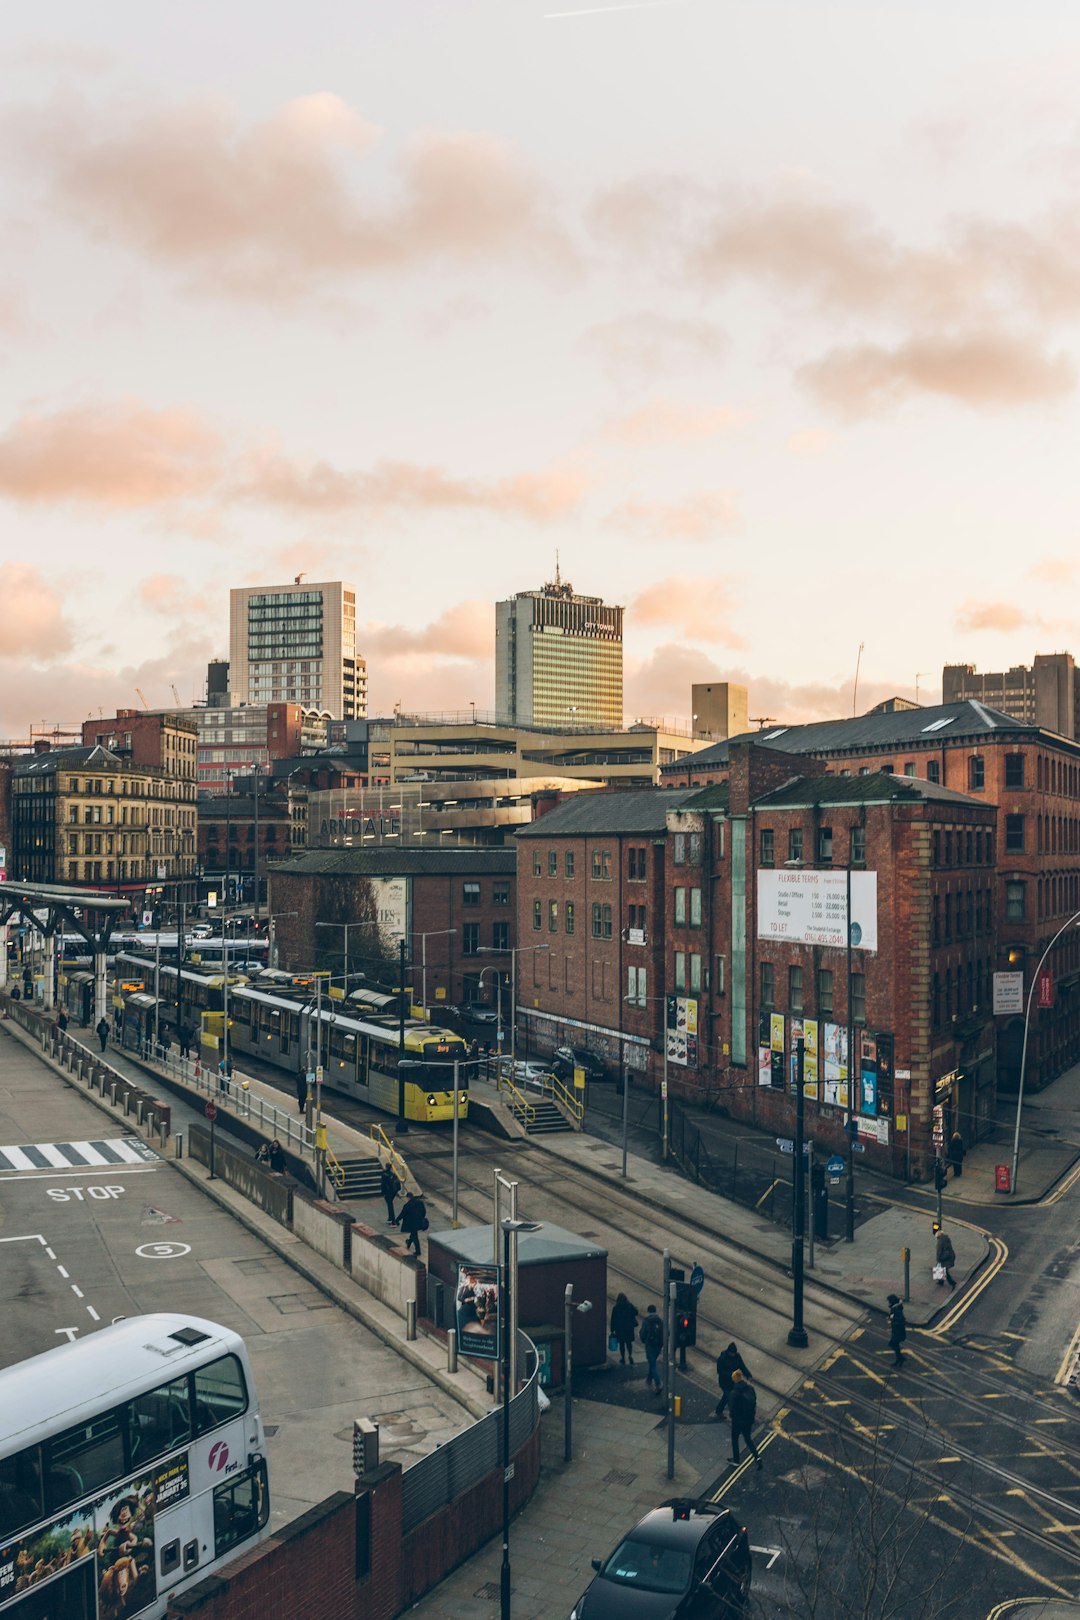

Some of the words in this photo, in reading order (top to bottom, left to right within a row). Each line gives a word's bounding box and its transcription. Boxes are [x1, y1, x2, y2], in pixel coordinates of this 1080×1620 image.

[597, 623, 615, 631] TOWER
[338, 809, 400, 817] MANCHESTER
[320, 818, 400, 835] ARNDALE
[778, 874, 801, 884] FLEXIBLE
[802, 875, 819, 884] TERMS
[770, 923, 777, 931] TO
[778, 923, 788, 932] LET
[829, 934, 844, 944] 2040
[46, 1185, 125, 1202] STOP
[154, 1245, 174, 1255] 5
[225, 1461, 238, 1474] First
[158, 1473, 168, 1482] NICK
[168, 1467, 179, 1477] PARK
[159, 1484, 165, 1493] IN
[165, 1475, 183, 1489] CINEMAS
[156, 1485, 180, 1504] JANUARY
[180, 1479, 188, 1489] 26
[0, 1571, 15, 1588] BUS
